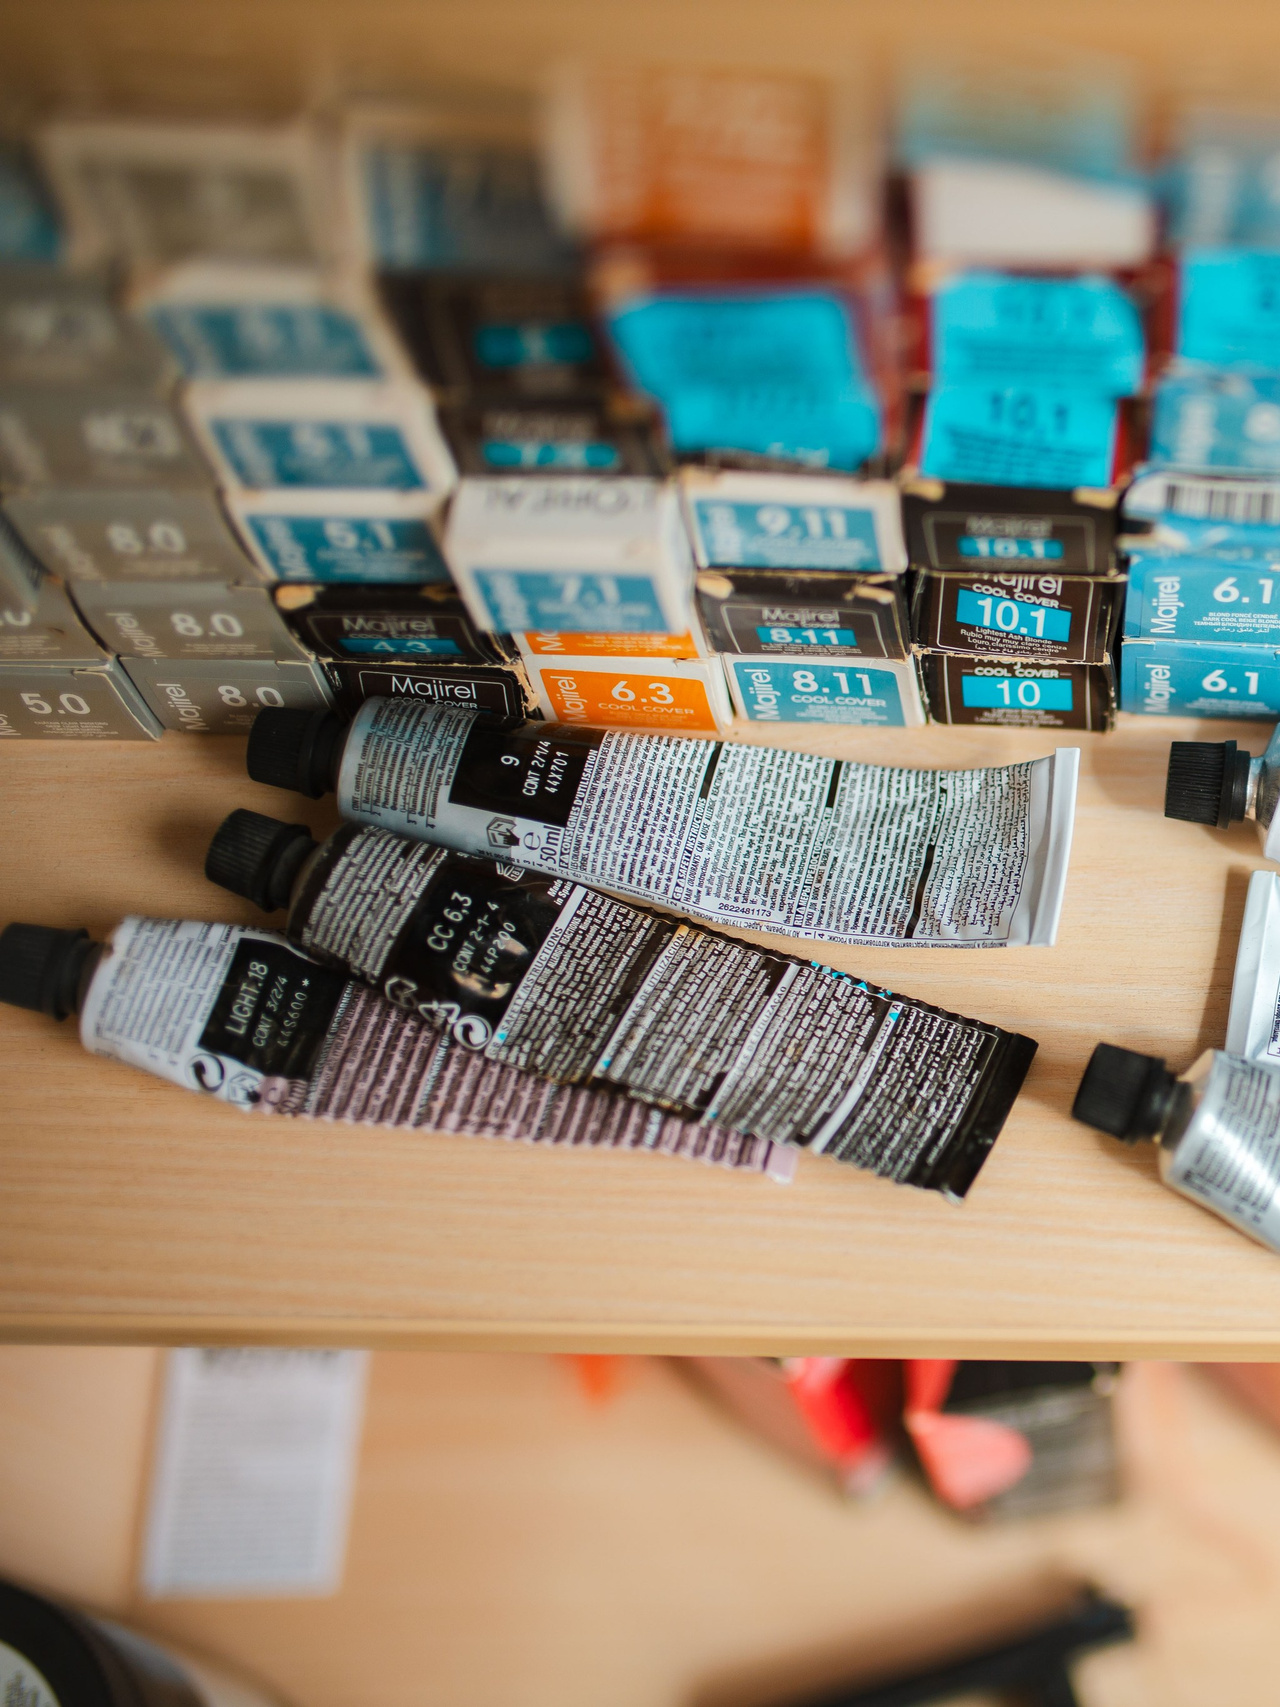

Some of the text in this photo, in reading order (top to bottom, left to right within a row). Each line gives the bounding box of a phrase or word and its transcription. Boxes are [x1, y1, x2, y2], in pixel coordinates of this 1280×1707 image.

[756, 506, 850, 540] 9.11
[106, 521, 187, 554] 8.0
[972, 583, 1060, 609] COOL COVER
[1213, 577, 1273, 604] 6.1
[762, 607, 839, 623] Majirel
[977, 597, 1046, 637] 10.1
[1150, 576, 1184, 634] Majirel
[105, 612, 168, 657] Majirel
[171, 613, 243, 637] 8.0
[342, 617, 436, 636] Majirel
[769, 627, 840, 645] 8.11
[975, 626, 1052, 645] Lightest Ash Blonde
[373, 641, 432, 653] 4.3
[960, 629, 984, 640] Rubio
[984, 634, 1001, 644] muy
[1002, 637, 1019, 646] muy
[1020, 639, 1041, 647] claro
[1042, 643, 1068, 651] ceniza
[792, 670, 873, 696] 8.11
[974, 667, 1059, 679] COOL COVER
[1202, 669, 1259, 695] 6.1
[217, 685, 285, 708] 8.0
[391, 676, 477, 700] Majirel
[550, 675, 589, 722] Majirel
[611, 680, 675, 705] 6.3
[744, 668, 781, 721] Majirel
[791, 694, 887, 708] COOL COVER
[996, 679, 1041, 707] 10
[1144, 664, 1176, 713] Majirel
[20, 692, 91, 715] 5.0
[156, 683, 210, 731] Majirel
[435, 699, 478, 710] COVER
[598, 702, 695, 716] COOL COVER
[500, 754, 520, 767] 9
[522, 740, 552, 797] CONT 2/1/4
[545, 751, 569, 794] 44X701
[561, 748, 597, 853] CONSIGNES D'UTILISATION
[541, 823, 561, 863] 50 ml
[671, 796, 707, 899] GB SAFETY INSTRUCTIONS
[547, 879, 563, 898] Made
[424, 889, 475, 953] CC 6,3
[717, 902, 771, 919] 2622481173
[450, 939, 478, 973] CONT
[478, 919, 517, 975] 44P200
[645, 933, 685, 994] UTILIZACIÓN
[500, 925, 563, 1032] SAFETY INSTRUCTIONS
[224, 958, 270, 1036] LIGHT.18
[250, 975, 289, 1048] CONT 3/2/4
